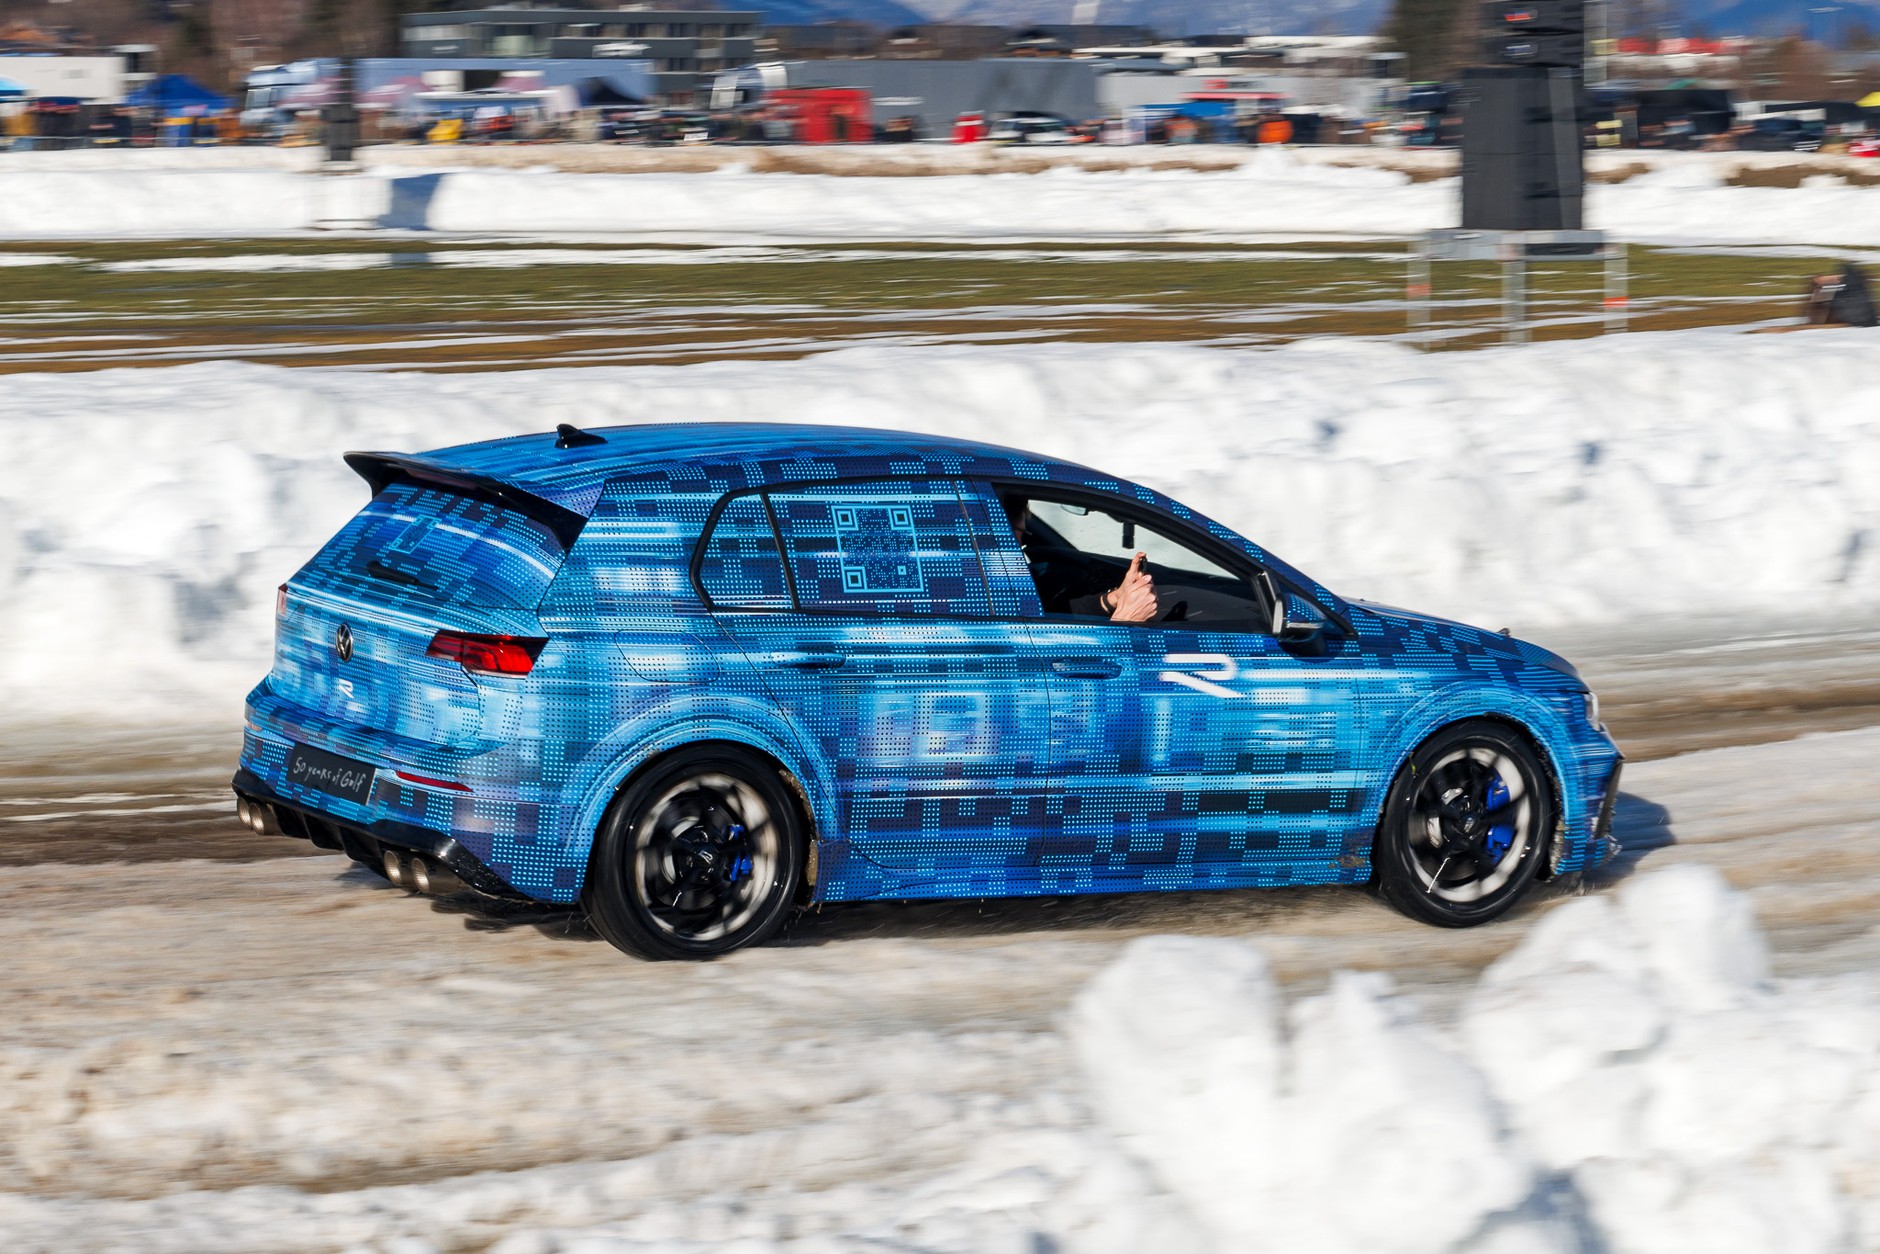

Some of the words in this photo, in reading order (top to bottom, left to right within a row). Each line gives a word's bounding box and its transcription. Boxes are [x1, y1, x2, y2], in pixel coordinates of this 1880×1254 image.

[338, 678, 355, 699] R
[1160, 653, 1244, 698] R
[293, 757, 307, 774] 50
[332, 768, 343, 786] of
[340, 771, 367, 792] Golf
